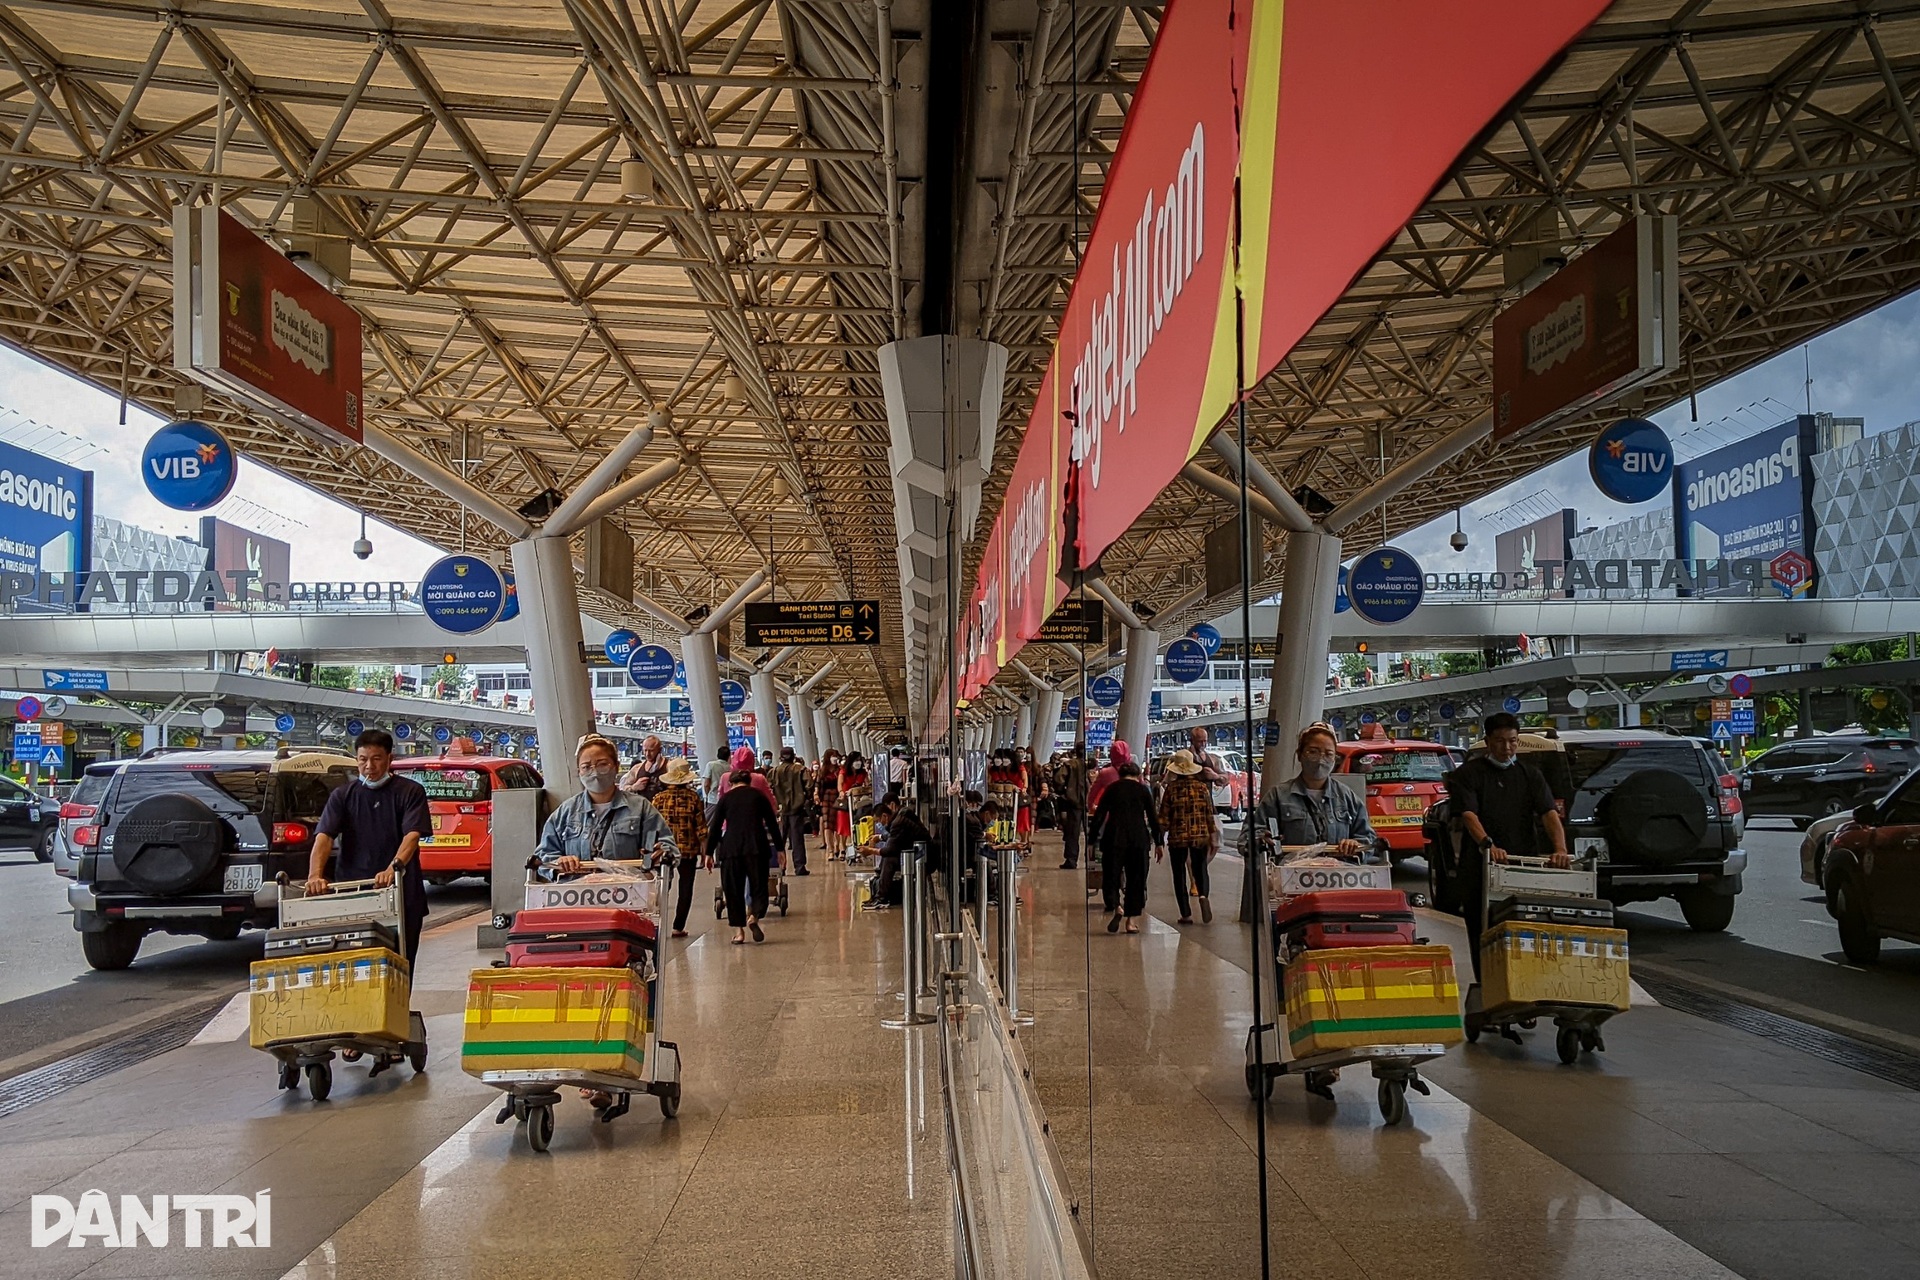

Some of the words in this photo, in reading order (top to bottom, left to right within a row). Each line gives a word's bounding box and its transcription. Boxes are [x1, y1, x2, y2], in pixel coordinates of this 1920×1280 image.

[151, 456, 200, 480] VIB
[0, 469, 76, 521] asonic
[0, 536, 15, 555] HÔNG
[25, 544, 36, 559] 24H
[5, 560, 19, 573] VIRUS
[1, 571, 258, 603] PHATDAT
[427, 591, 444, 599] MỜI
[446, 590, 476, 599] QUẢNG
[477, 590, 496, 598] CÁO
[441, 607, 455, 615] 090
[471, 606, 489, 614] 6699
[780, 604, 800, 612] SẢNH
[801, 604, 817, 612] ĐÓN
[832, 624, 853, 638] D6
[609, 643, 630, 654] VIB
[46, 723, 58, 731] CẤM
[19, 737, 31, 745] LÀN
[233, 867, 253, 878] 51A
[225, 878, 260, 891] 281.87
[547, 887, 629, 906] DORCO
